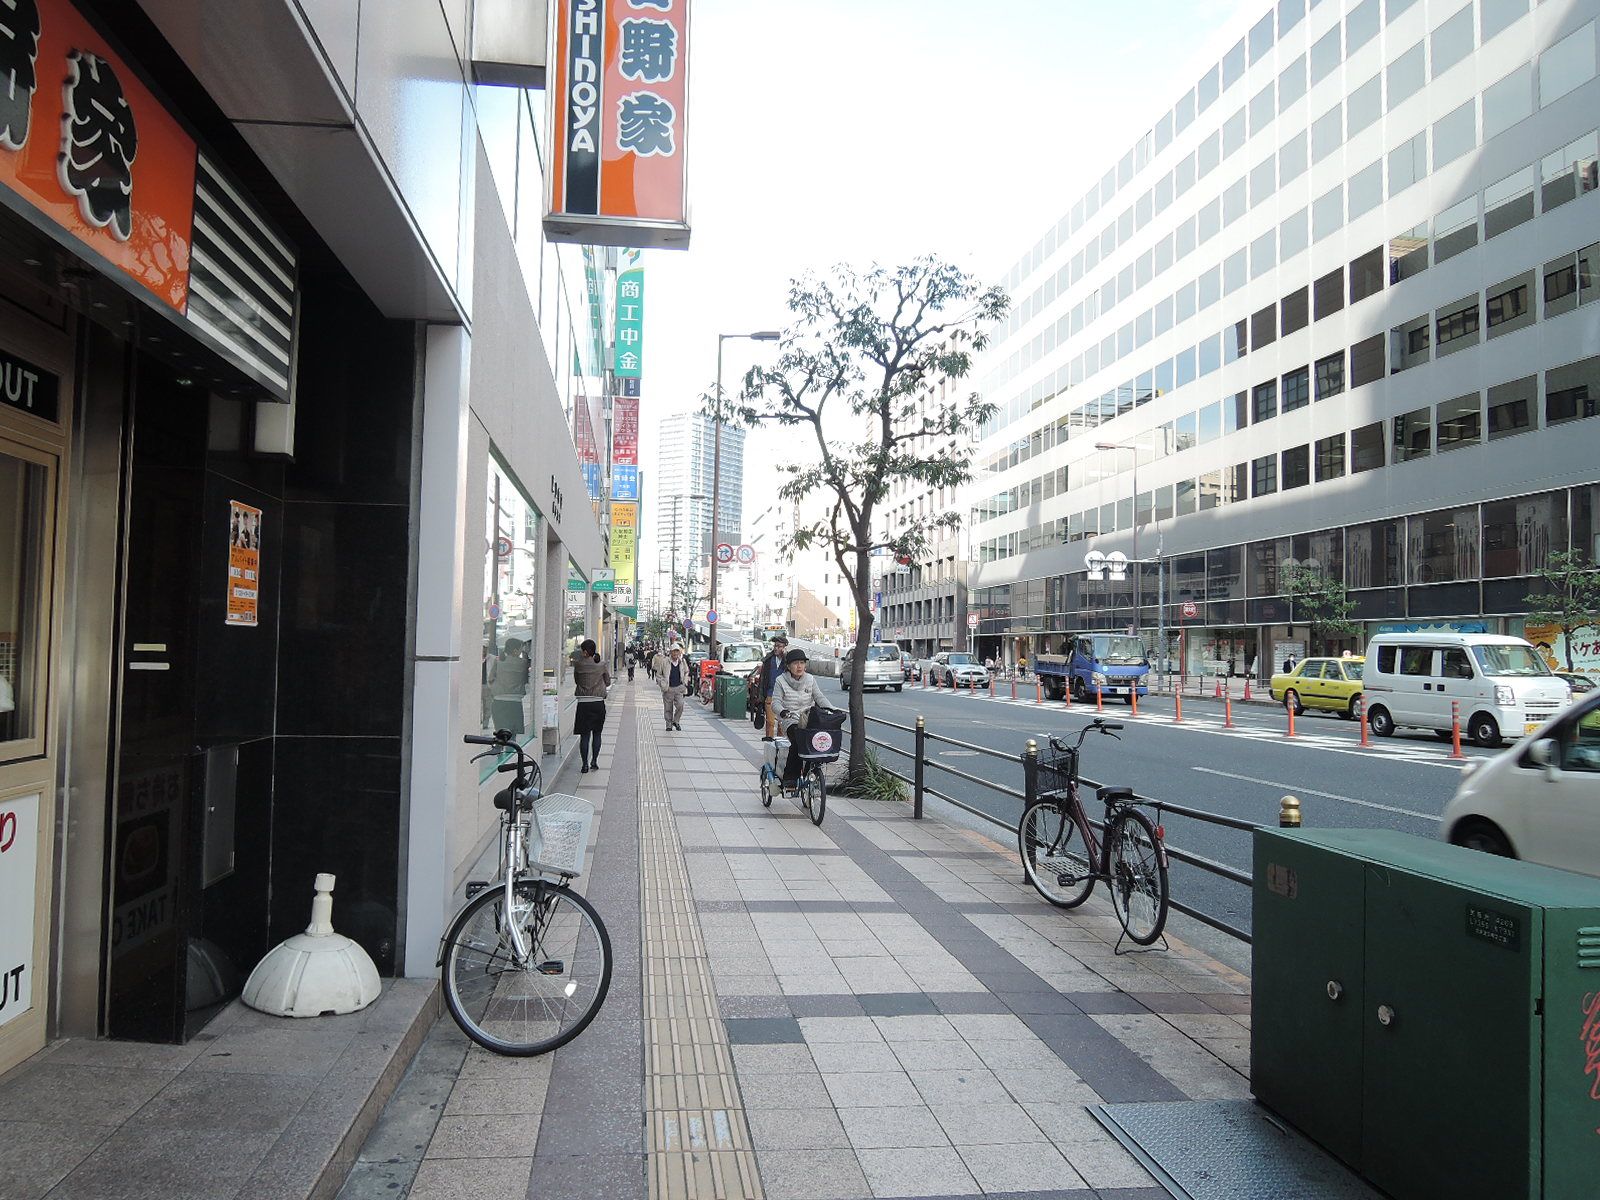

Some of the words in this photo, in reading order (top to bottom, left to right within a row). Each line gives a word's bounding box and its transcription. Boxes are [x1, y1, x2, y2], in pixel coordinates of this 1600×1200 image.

[616, 0, 678, 157] 野家
[619, 280, 640, 370] 商工中金
[0, 361, 39, 408] UT
